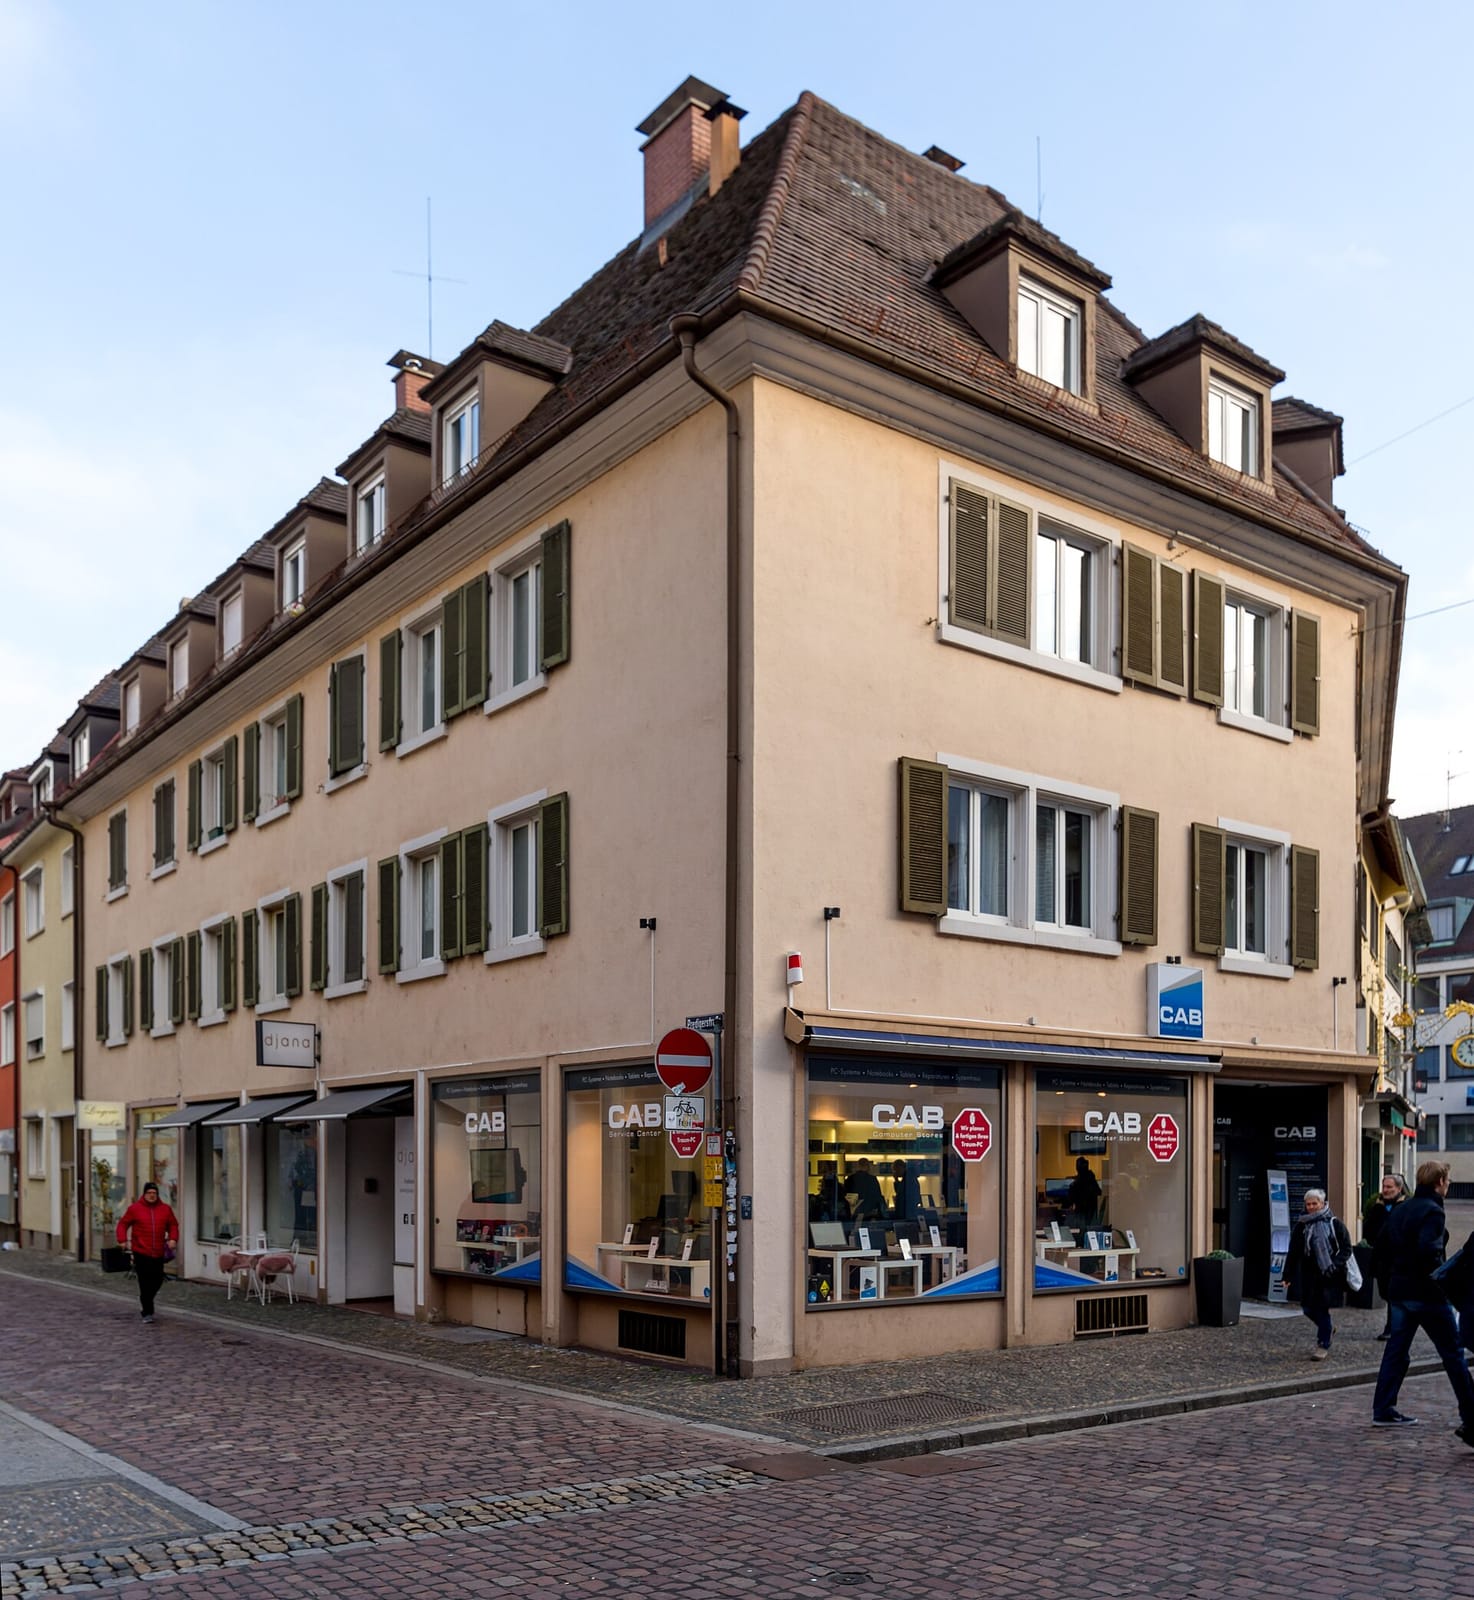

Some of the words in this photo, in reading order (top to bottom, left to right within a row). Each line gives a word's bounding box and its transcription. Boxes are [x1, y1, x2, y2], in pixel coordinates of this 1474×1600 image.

[1160, 1005, 1202, 1026] CAB
[264, 1033, 310, 1050] djana
[465, 1111, 505, 1133] CAB
[608, 1103, 662, 1128] CAB
[872, 1104, 944, 1130] CAB
[1084, 1110, 1141, 1134] CAB
[1216, 1117, 1232, 1125] CAB
[609, 1131, 634, 1139] Service
[637, 1130, 662, 1138] Center
[873, 1131, 913, 1139] Computer
[1274, 1126, 1317, 1138] CAB
